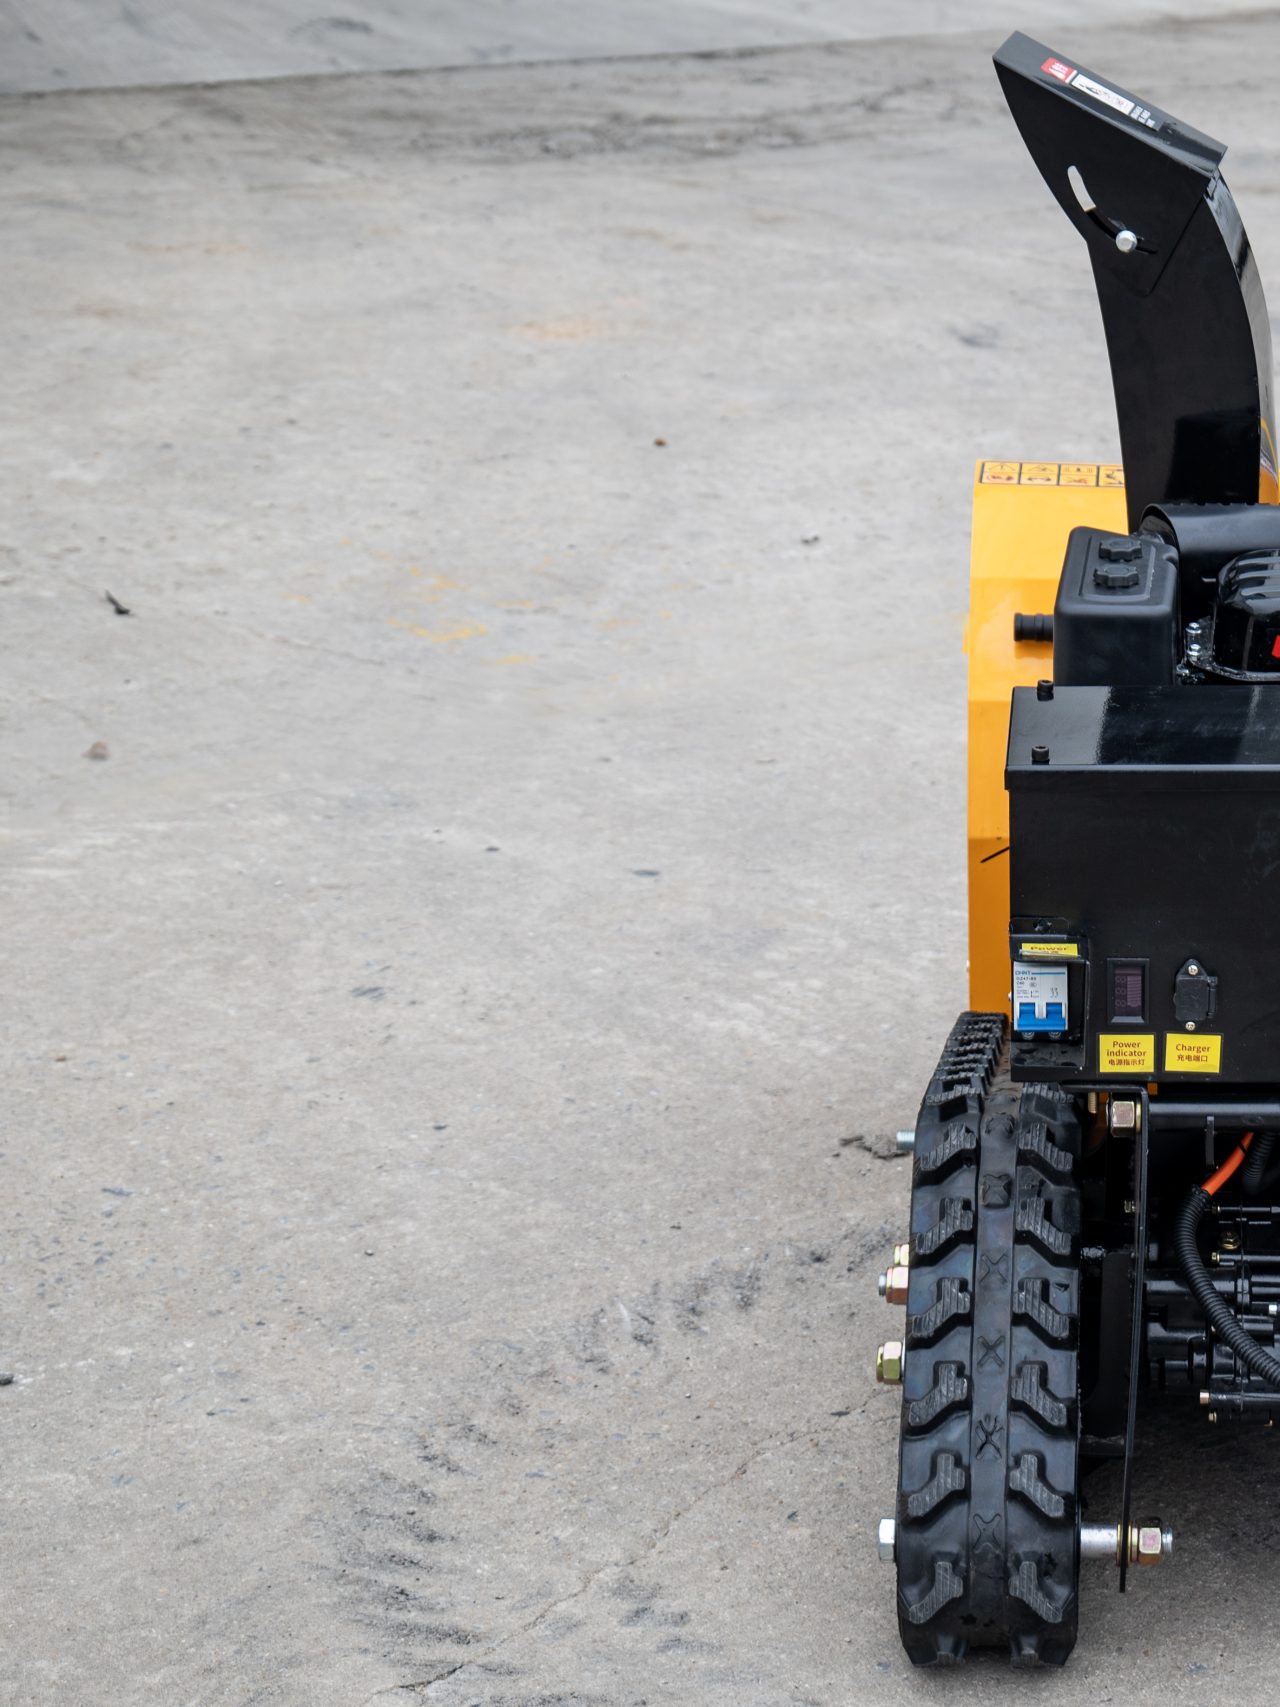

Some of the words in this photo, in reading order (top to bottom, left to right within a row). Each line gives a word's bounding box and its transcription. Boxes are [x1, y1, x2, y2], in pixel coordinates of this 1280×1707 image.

[1112, 1040, 1141, 1048] Power
[1175, 1043, 1211, 1053] Charger
[1108, 1058, 1145, 1066] 电源指示灯
[1177, 1054, 1208, 1062] 充电端口
